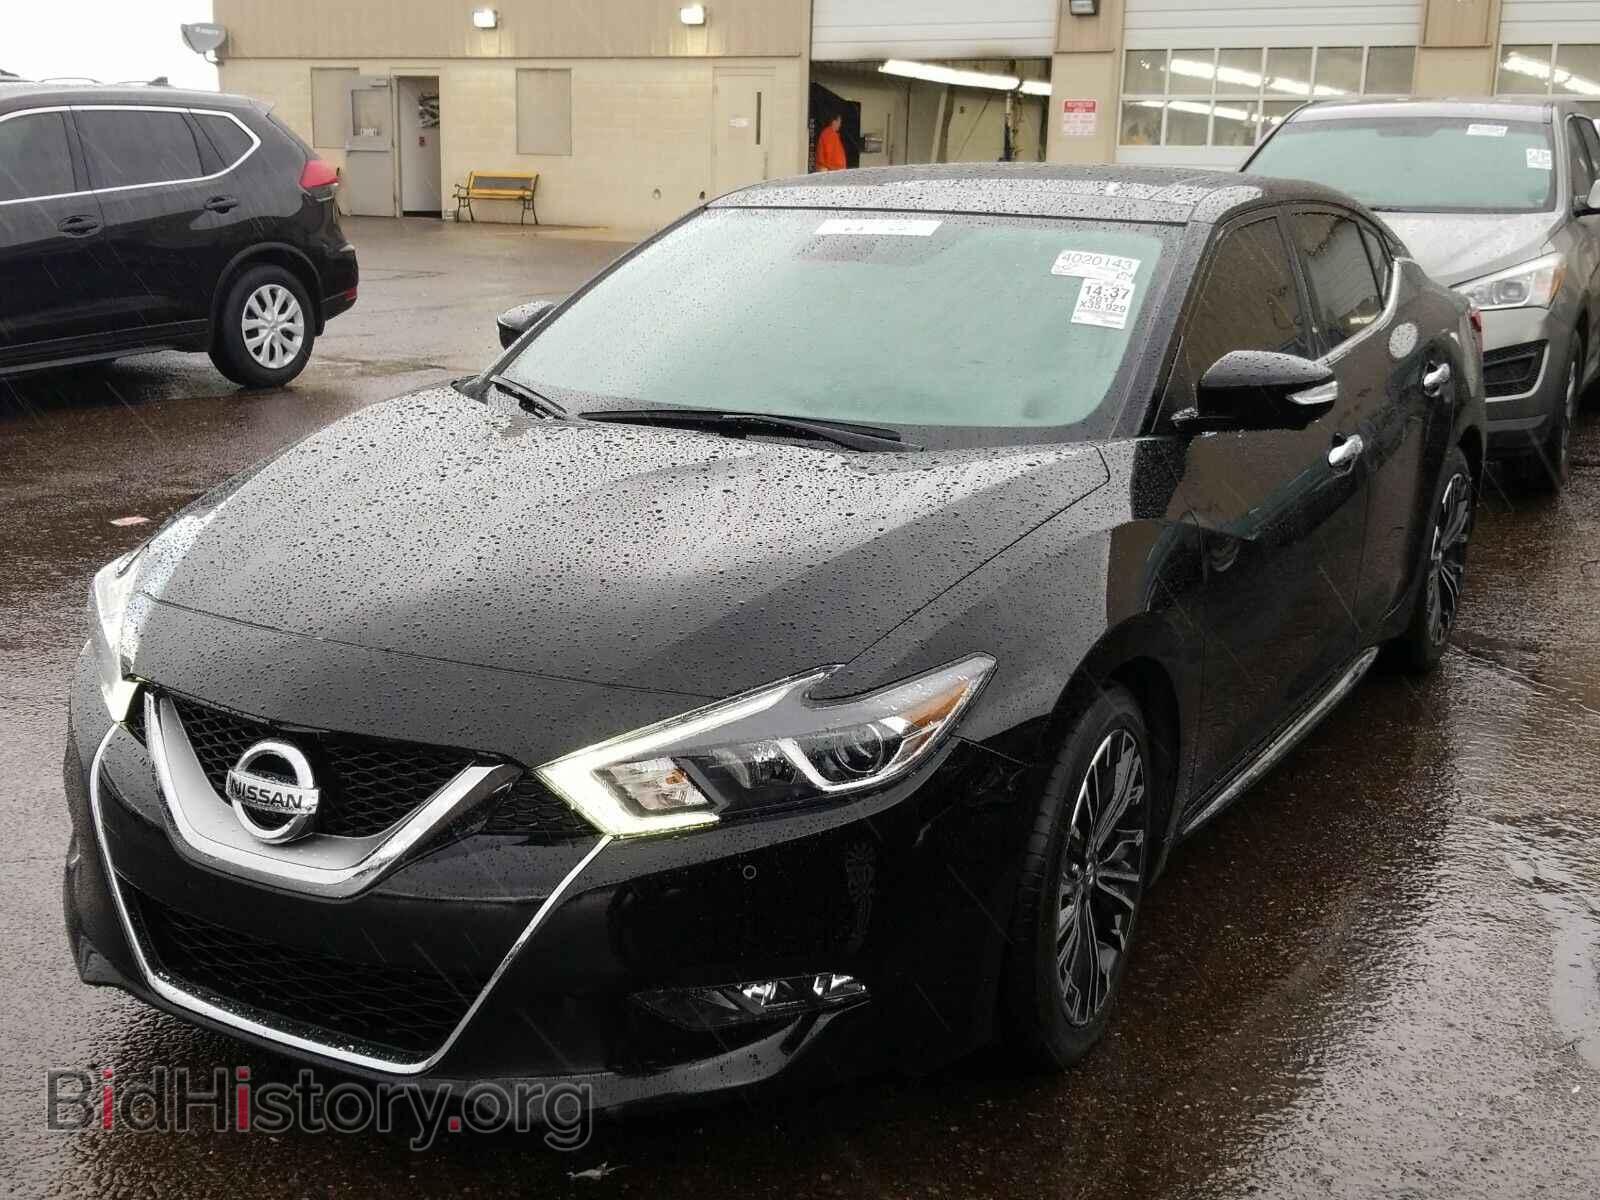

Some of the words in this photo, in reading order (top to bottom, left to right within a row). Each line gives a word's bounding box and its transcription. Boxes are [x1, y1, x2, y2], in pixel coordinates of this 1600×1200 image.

[1061, 253, 1133, 270] 4020143
[1085, 286, 1130, 300] 14:37
[229, 777, 303, 809] NISSAN
